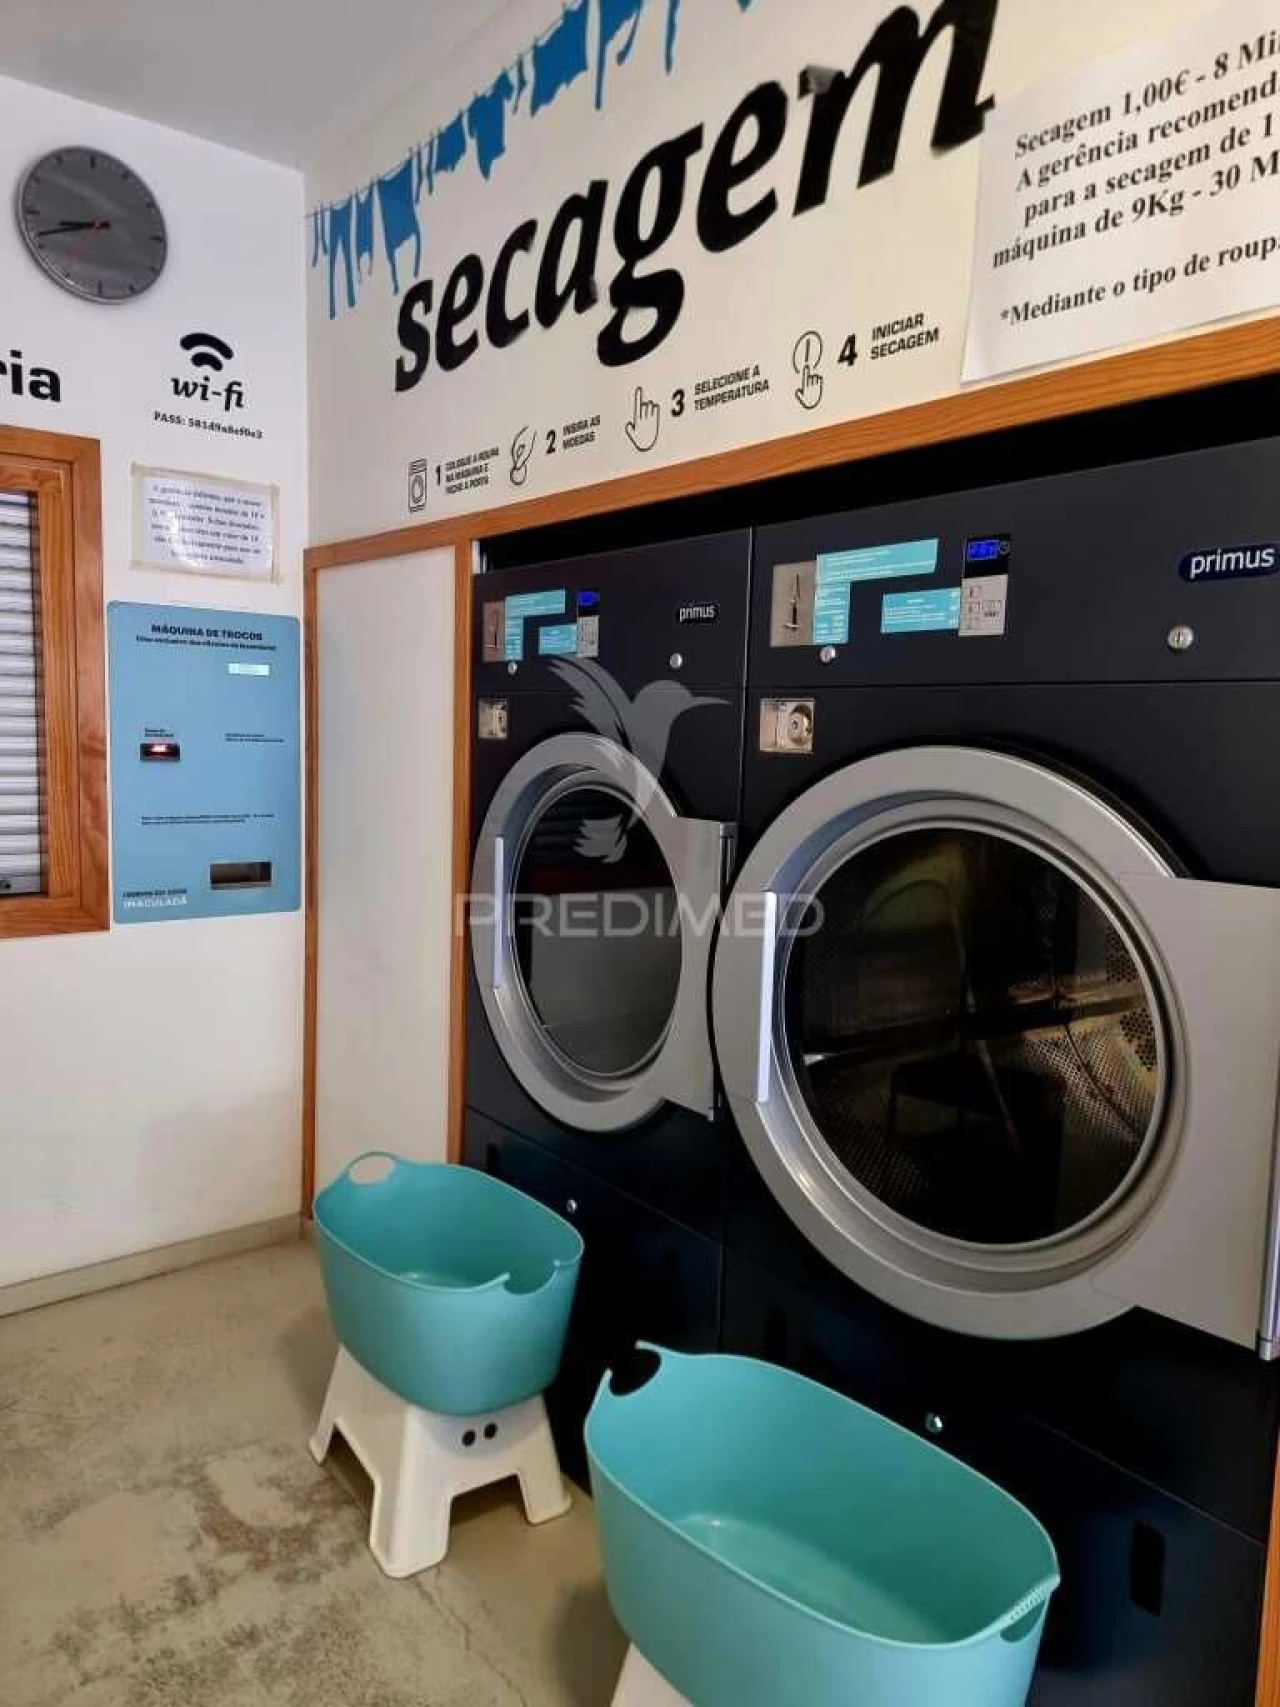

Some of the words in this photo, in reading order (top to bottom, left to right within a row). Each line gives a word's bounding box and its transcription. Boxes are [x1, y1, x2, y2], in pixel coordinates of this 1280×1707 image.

[1014, 104, 1112, 160] Secagem
[1122, 68, 1190, 117] 1,00€
[1212, 52, 1229, 80] 8
[1236, 29, 1280, 70] Mi
[1015, 167, 1032, 192] A
[1037, 130, 1139, 188] gerência
[1147, 69, 1280, 144] recomend
[1024, 187, 1077, 228] para
[1083, 182, 1098, 201] a
[1104, 142, 1211, 195] secagem
[1219, 126, 1252, 154] de
[1262, 111, 1274, 138] 1
[394, 0, 996, 393] secagem
[992, 219, 1087, 269] máquina
[1094, 207, 1124, 234] de
[1130, 187, 1185, 222] 9Kg
[1208, 164, 1241, 197] 30
[1112, 279, 1126, 297] o
[1132, 265, 1176, 294] tipo
[1183, 253, 1211, 278] de
[1217, 236, 1280, 268] roup
[837, 333, 858, 367] 4
[871, 312, 925, 341] INICIAR
[869, 326, 940, 360] SECAGEM
[169, 375, 244, 413] wi-fi
[670, 388, 686, 418] 3
[693, 369, 751, 396] SELECIONE
[751, 363, 761, 378] A
[693, 379, 770, 412] TEMPERATURA
[153, 410, 186, 425] PASS:
[546, 429, 556, 454] 2
[562, 431, 597, 450] MOEDAS
[434, 464, 441, 487] 1
[1189, 546, 1275, 579] primus
[151, 623, 204, 637] MÁQUINA
[206, 629, 219, 639] DE
[679, 603, 716, 623] primus
